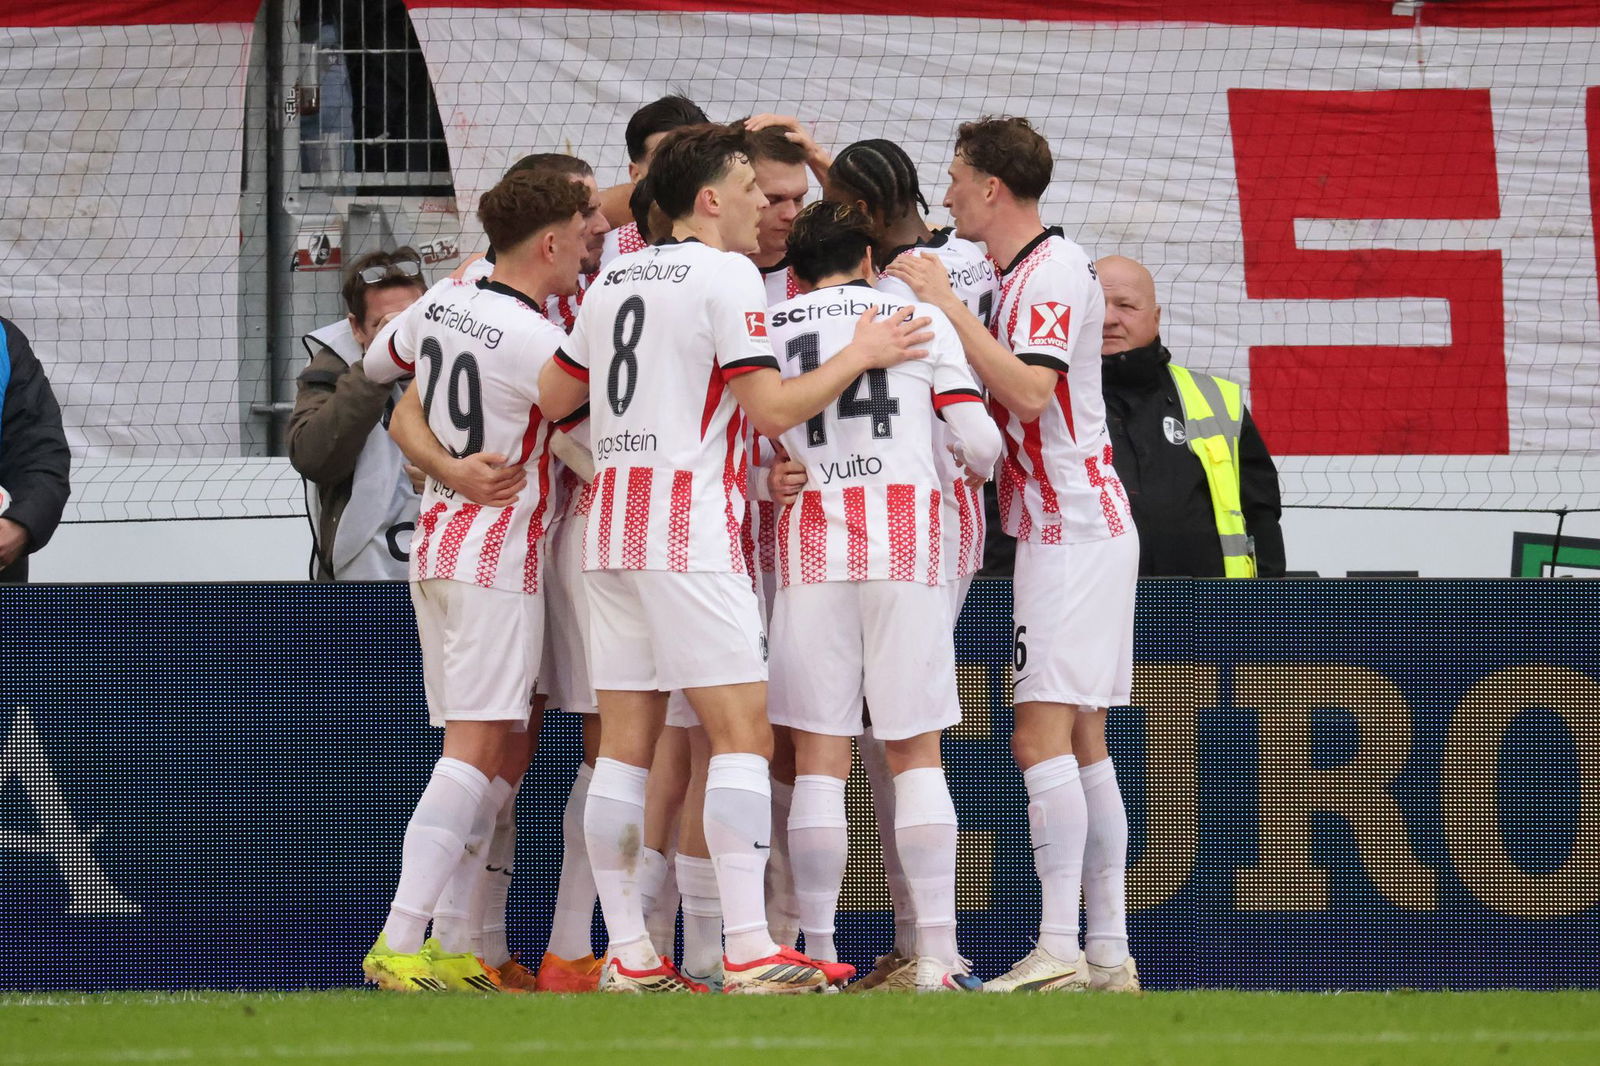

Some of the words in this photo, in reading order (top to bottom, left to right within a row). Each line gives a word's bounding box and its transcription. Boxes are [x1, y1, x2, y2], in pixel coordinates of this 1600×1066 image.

[606, 294, 646, 418] 8
[785, 330, 901, 449] 14
[820, 453, 883, 485] yuito
[1013, 625, 1027, 672] 6
